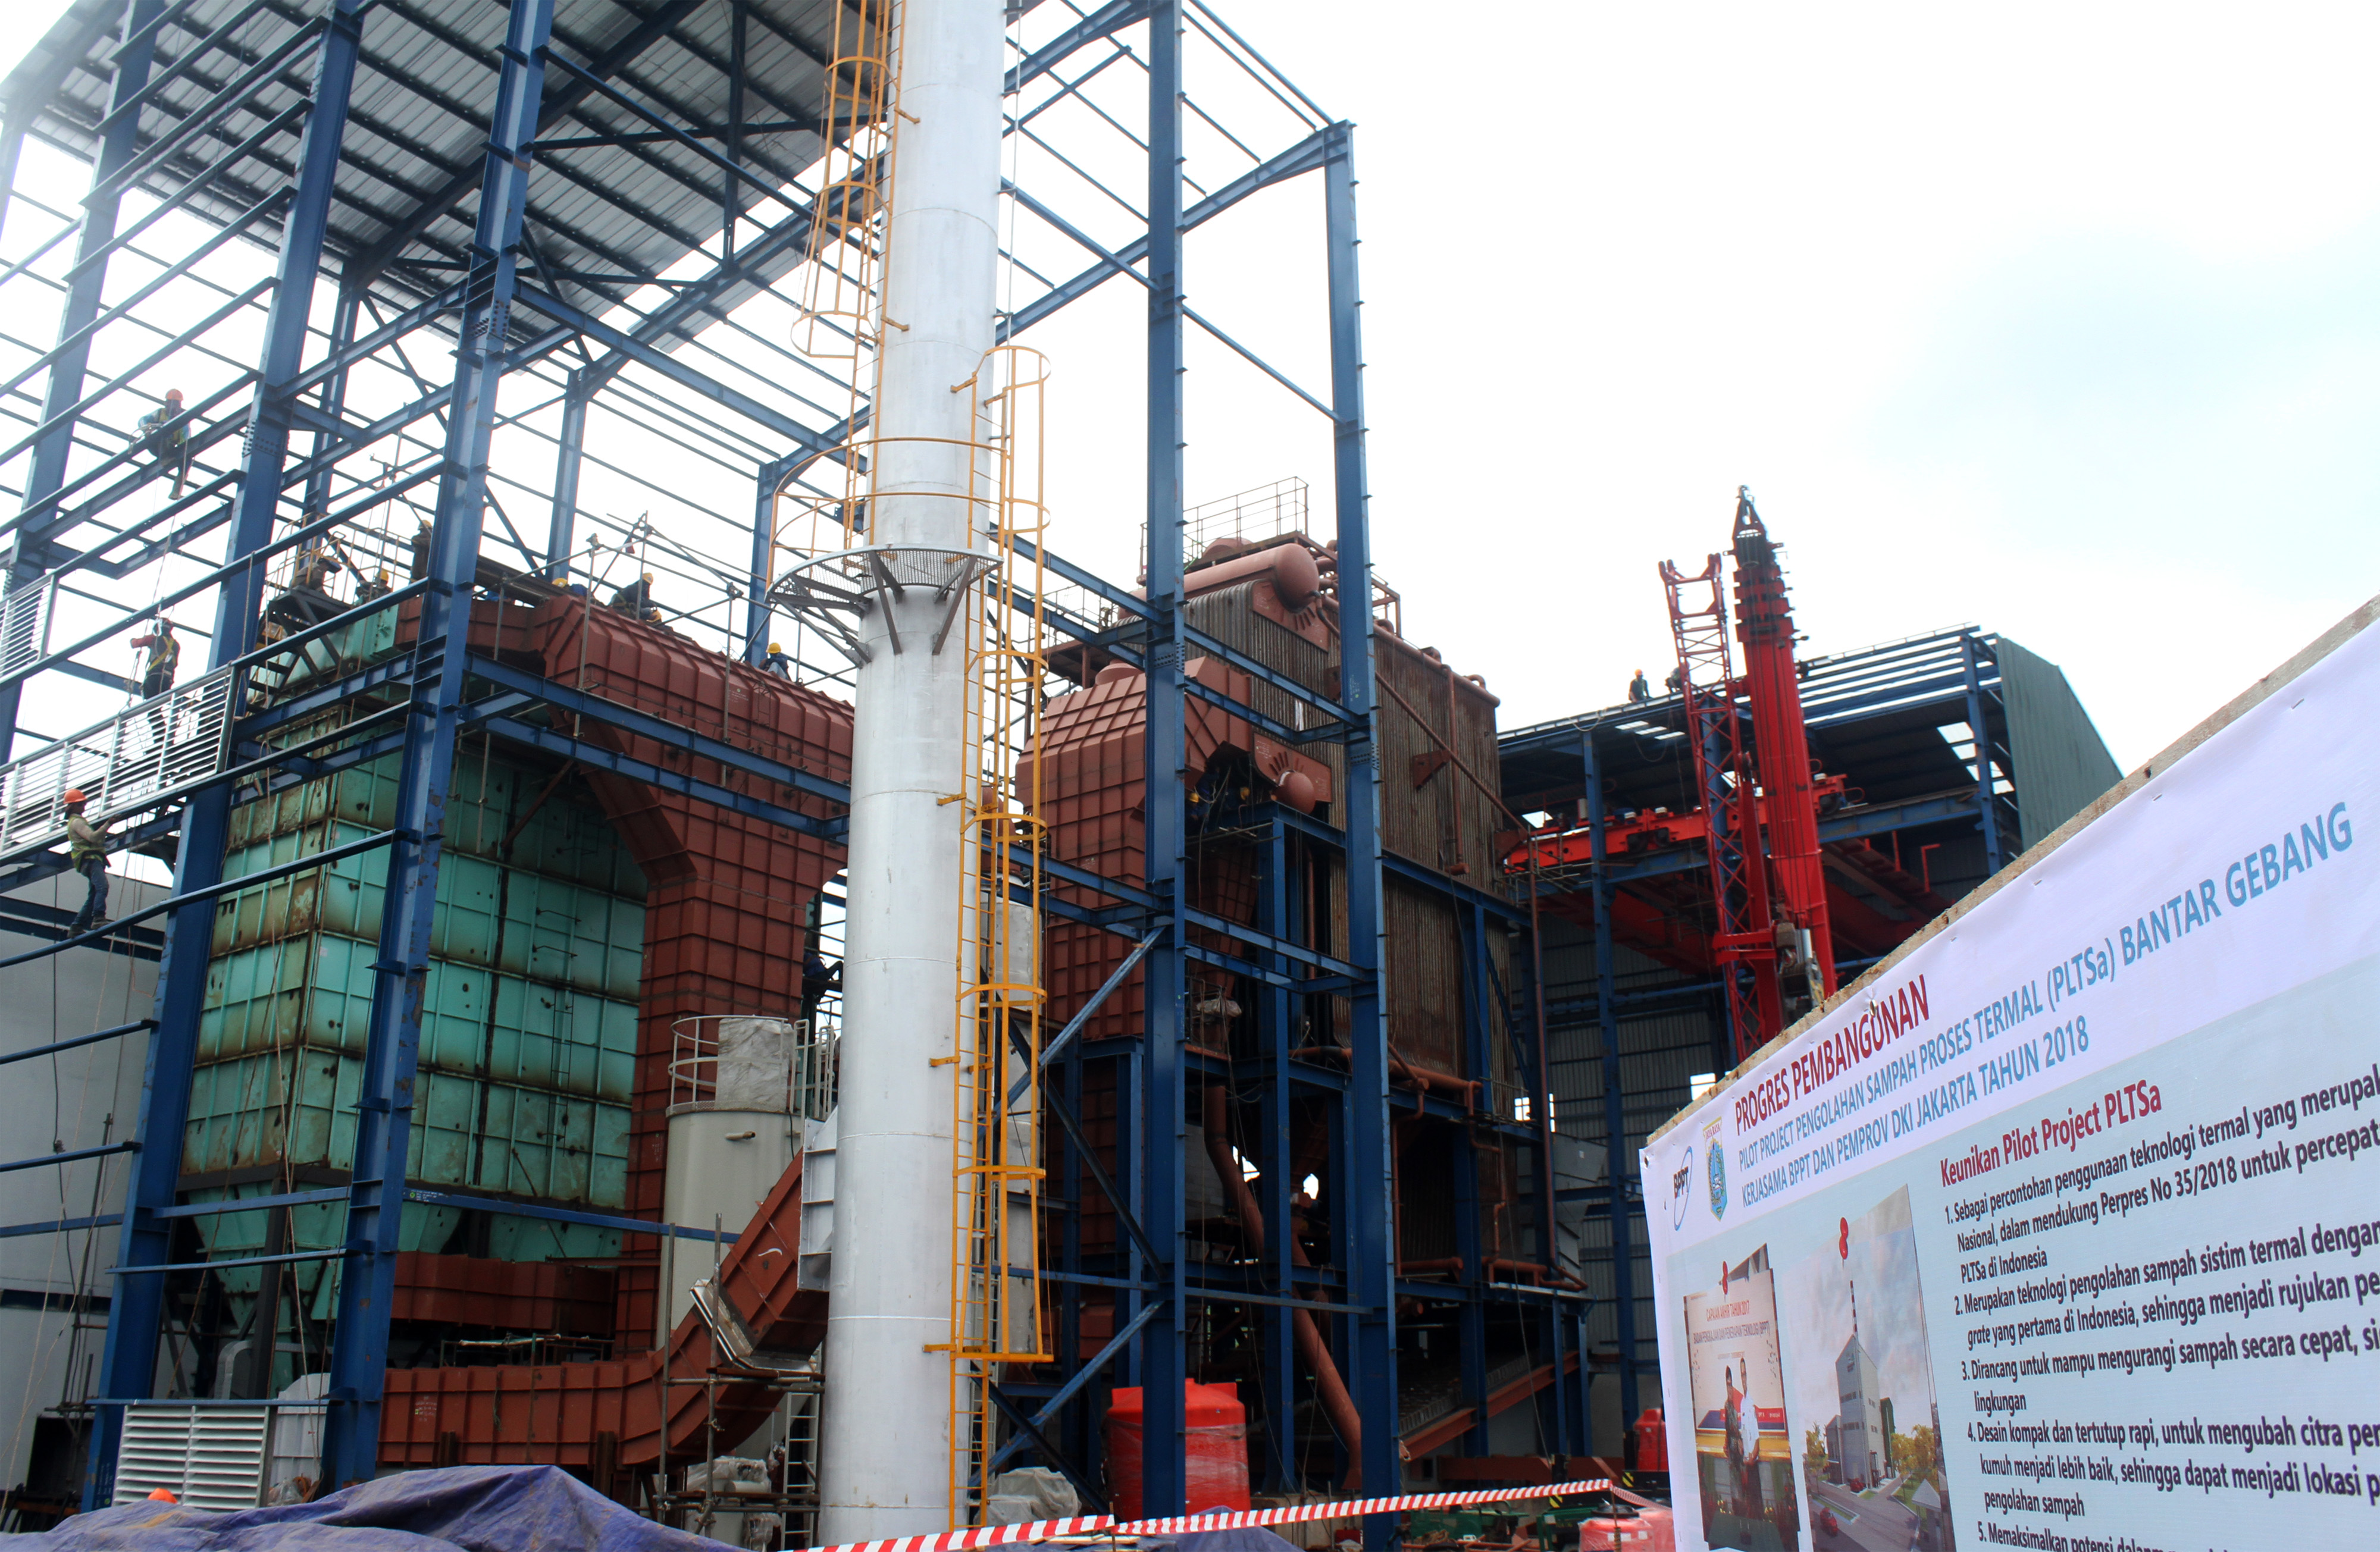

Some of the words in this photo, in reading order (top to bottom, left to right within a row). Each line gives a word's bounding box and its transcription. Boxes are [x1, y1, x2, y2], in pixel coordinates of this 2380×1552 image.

[1740, 1142, 1757, 1171] PILOT
[1761, 1121, 1793, 1159] PROJECT
[1796, 1081, 1864, 1140] PENGOLAHAN
[1867, 1051, 1916, 1103] SAMPAH
[1919, 1018, 1971, 1074] PROSES
[1974, 981, 2043, 1042] TERMAL
[2048, 938, 2114, 1011] (PLTSa)
[2120, 880, 2221, 965] BANTAR
[2226, 802, 2352, 907] GEBANG
[1736, 1068, 1789, 1136] PROGRES
[1791, 974, 1929, 1100] PEMBANGUNAN
[1743, 1167, 1787, 1206] KERJASAMA
[1789, 1154, 1809, 1185] BPPT
[1813, 1142, 1834, 1174] DAN
[1837, 1115, 1887, 1163] PEMPROV
[1892, 1103, 1913, 1137] DKI
[1918, 1072, 1977, 1127] JAKARTA
[1979, 1040, 2039, 1095] TAHUN
[2044, 1016, 2088, 1067] 2018
[1941, 1145, 2000, 1187] Keunikan
[2003, 1127, 2038, 1164] Pilot
[2042, 1102, 2101, 1152] Project
[2105, 1080, 2161, 1128] PLTSa
[1673, 1166, 1689, 1199] BPPT
[1946, 1206, 1953, 1224] 1.
[1955, 1193, 1988, 1222] Sebagai
[1990, 1177, 2052, 1216] percontohan
[2055, 1155, 2127, 1197] penggunaan
[2131, 1125, 2196, 1168] teknologi
[2199, 1106, 2250, 1147] termal
[2253, 1100, 2296, 1139] yang
[1958, 1223, 1997, 1252] Nasional,
[2001, 1218, 2030, 1241] dalam
[2033, 1202, 2098, 1233] mendukung
[2100, 1187, 2148, 1217] Perpres
[2151, 1177, 2171, 1202] No
[2175, 1156, 2237, 1196] 35/2018
[2241, 1141, 2291, 1179] untuk
[2296, 1119, 2380, 1174] percepat
[1955, 1296, 1962, 1315] 2.
[1965, 1287, 2015, 1315] Merupakan
[2018, 1274, 2066, 1304] teknologi
[2070, 1263, 2140, 1302] pengolahan
[2144, 1249, 2197, 1286] sampah
[2201, 1242, 2246, 1273] sistim
[2250, 1227, 2307, 1264] termal
[1961, 1261, 1987, 1283] PLTSa
[1989, 1256, 1997, 1277] di
[1999, 1246, 2047, 1275] Indonesia
[1968, 1325, 1990, 1351] grate
[1993, 1325, 2015, 1347] yang
[2018, 1318, 2061, 1344] pertama
[2064, 1309, 2075, 1332] di
[2077, 1301, 2138, 1330] Indonesia,
[2143, 1294, 2206, 1325] sehingga
[2210, 1279, 2274, 1318] menjadi
[2279, 1272, 2350, 1312] rujukan
[2355, 1272, 2380, 1305] pe
[1962, 1362, 1969, 1380] 3.
[1972, 1359, 2017, 1382] Dirancang
[2020, 1352, 2050, 1375] untuk
[2053, 1355, 2094, 1378] mampu
[2098, 1339, 2175, 1375] mengurangi
[2179, 1332, 2238, 1369] sampah
[2242, 1335, 2295, 1359] secara
[2300, 1325, 2357, 1362] cepat,
[2363, 1318, 2380, 1350] si
[1968, 1423, 1975, 1441] 4.
[1978, 1421, 2008, 1441] Desain
[2009, 1420, 2050, 1448] kompak
[2053, 1420, 2073, 1442] dan
[2075, 1422, 2125, 1450] tertutup
[2129, 1418, 2158, 1450] rapi,
[2162, 1417, 2204, 1444] untuk
[2208, 1416, 2296, 1453] mengubah
[2301, 1416, 2343, 1446] citra
[1975, 1391, 2026, 1417] lingkungan
[1981, 1454, 2012, 1475] kumuh
[2015, 1455, 2055, 1484] menjadi
[2058, 1456, 2085, 1479] lebih
[2088, 1456, 2118, 1485] baik,
[2121, 1457, 2181, 1491] sehingga
[2185, 1459, 2228, 1494] dapat
[2232, 1462, 2300, 1498] menjadi
[2304, 1463, 2361, 1495] lokasi
[1985, 1488, 2040, 1515] pengolahan
[2043, 1493, 2084, 1521] sampah
[1978, 1522, 1986, 1541] 5.
[1988, 1523, 2068, 1552] Memaksimalkan
